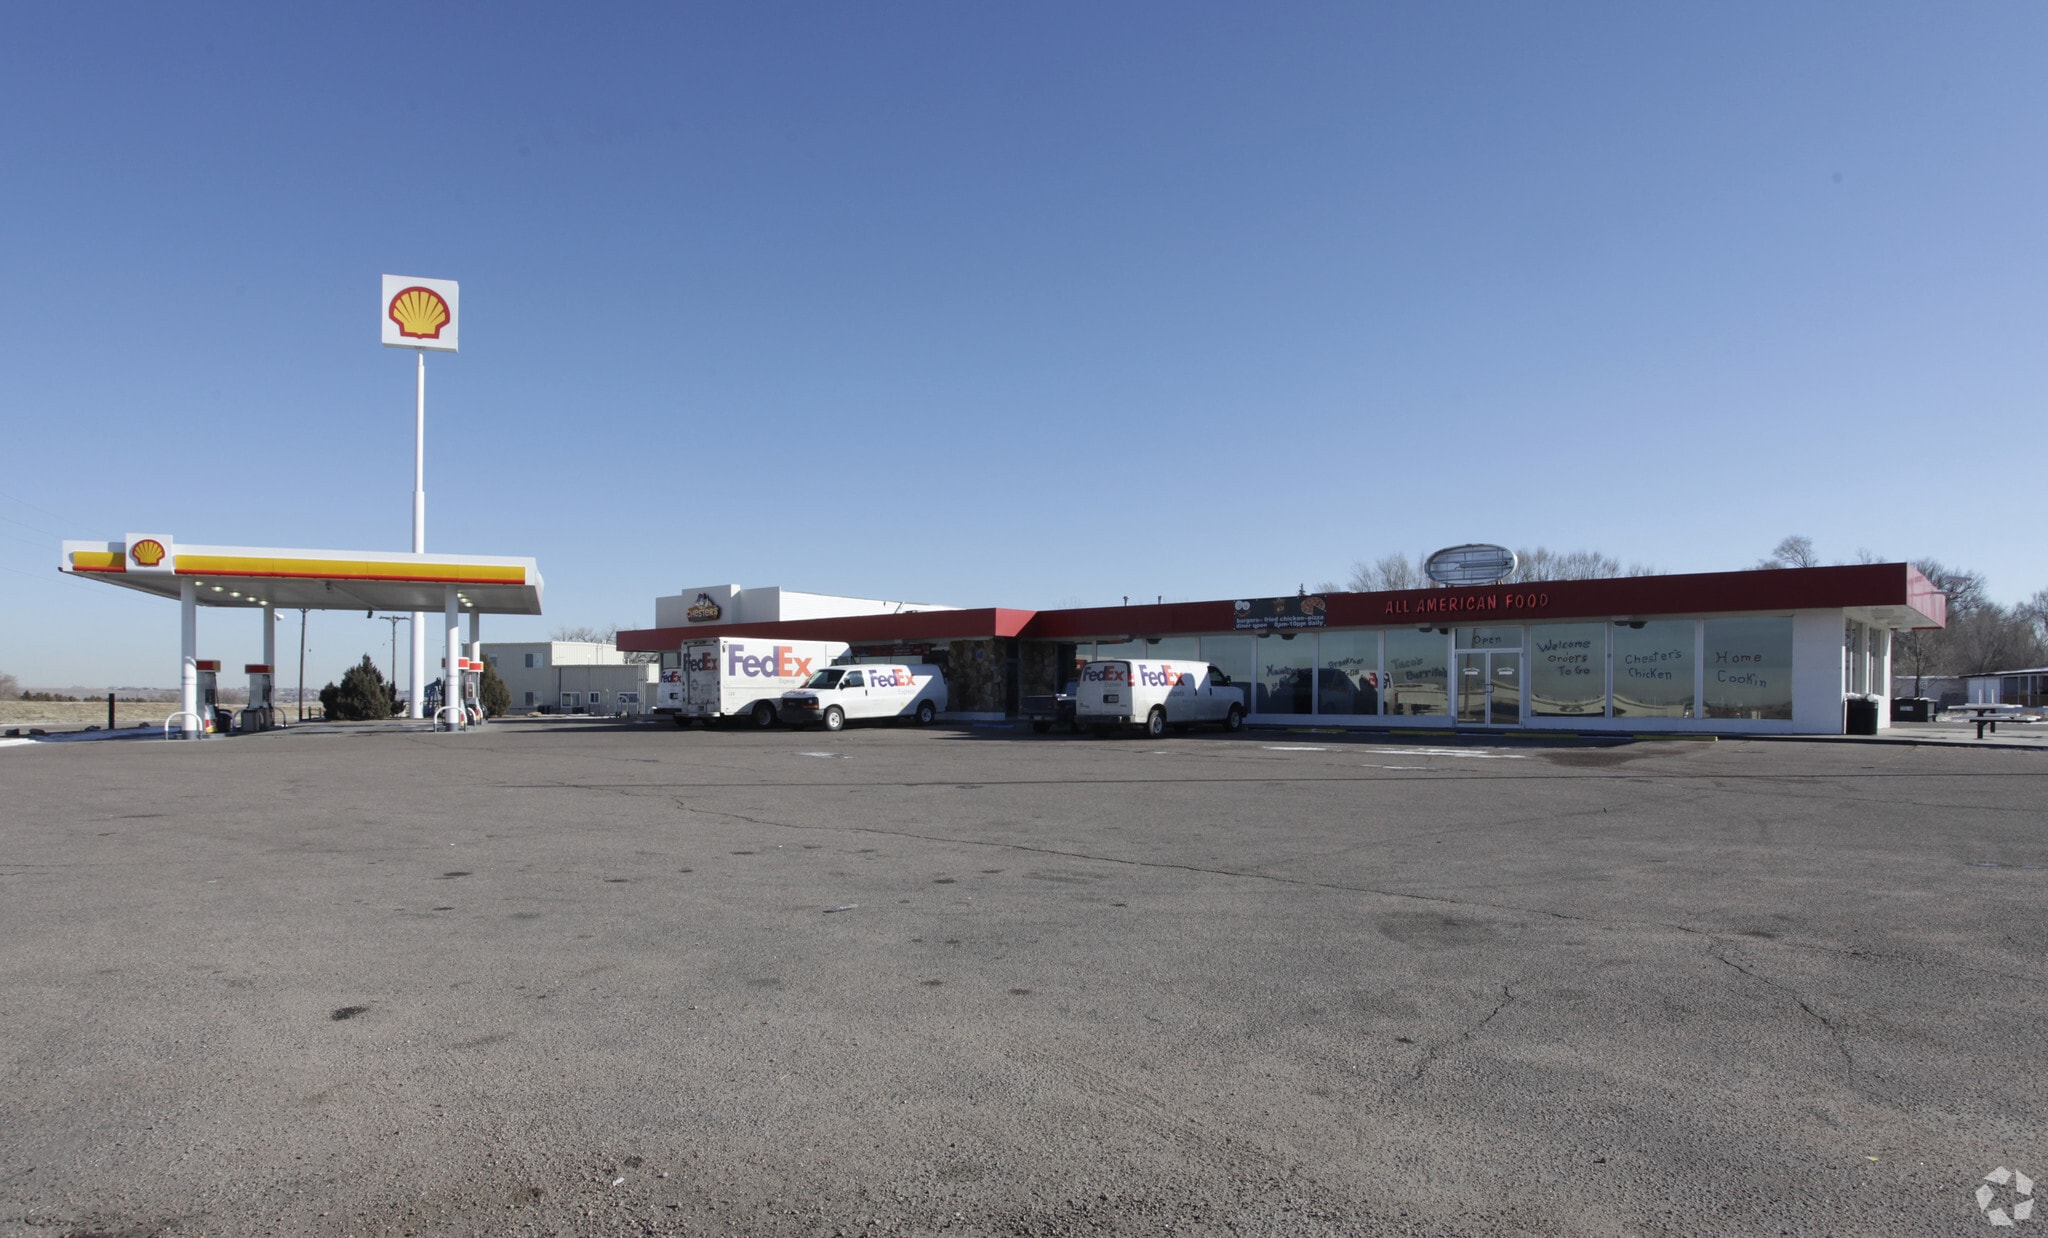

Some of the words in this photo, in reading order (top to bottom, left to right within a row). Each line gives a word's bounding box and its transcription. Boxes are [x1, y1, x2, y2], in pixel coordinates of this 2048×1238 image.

[1385, 600, 1411, 615] ALL
[1417, 594, 1498, 613] AMERICAN
[1506, 592, 1549, 610] FOOD
[1264, 615, 1279, 623] fried
[1473, 634, 1501, 646] Open
[1536, 639, 1592, 653] Welcome
[683, 653, 718, 671] FedEx
[729, 644, 812, 677] FedEx
[1547, 651, 1588, 664] Orders
[1625, 649, 1683, 665] Chester's
[1716, 650, 1762, 664] Home
[660, 671, 682, 683] FedEx
[868, 669, 916, 688] FedEx
[1082, 665, 1125, 682] FedEx
[1138, 664, 1185, 687] FedEx
[1557, 665, 1572, 677] To
[1575, 665, 1591, 676] Go
